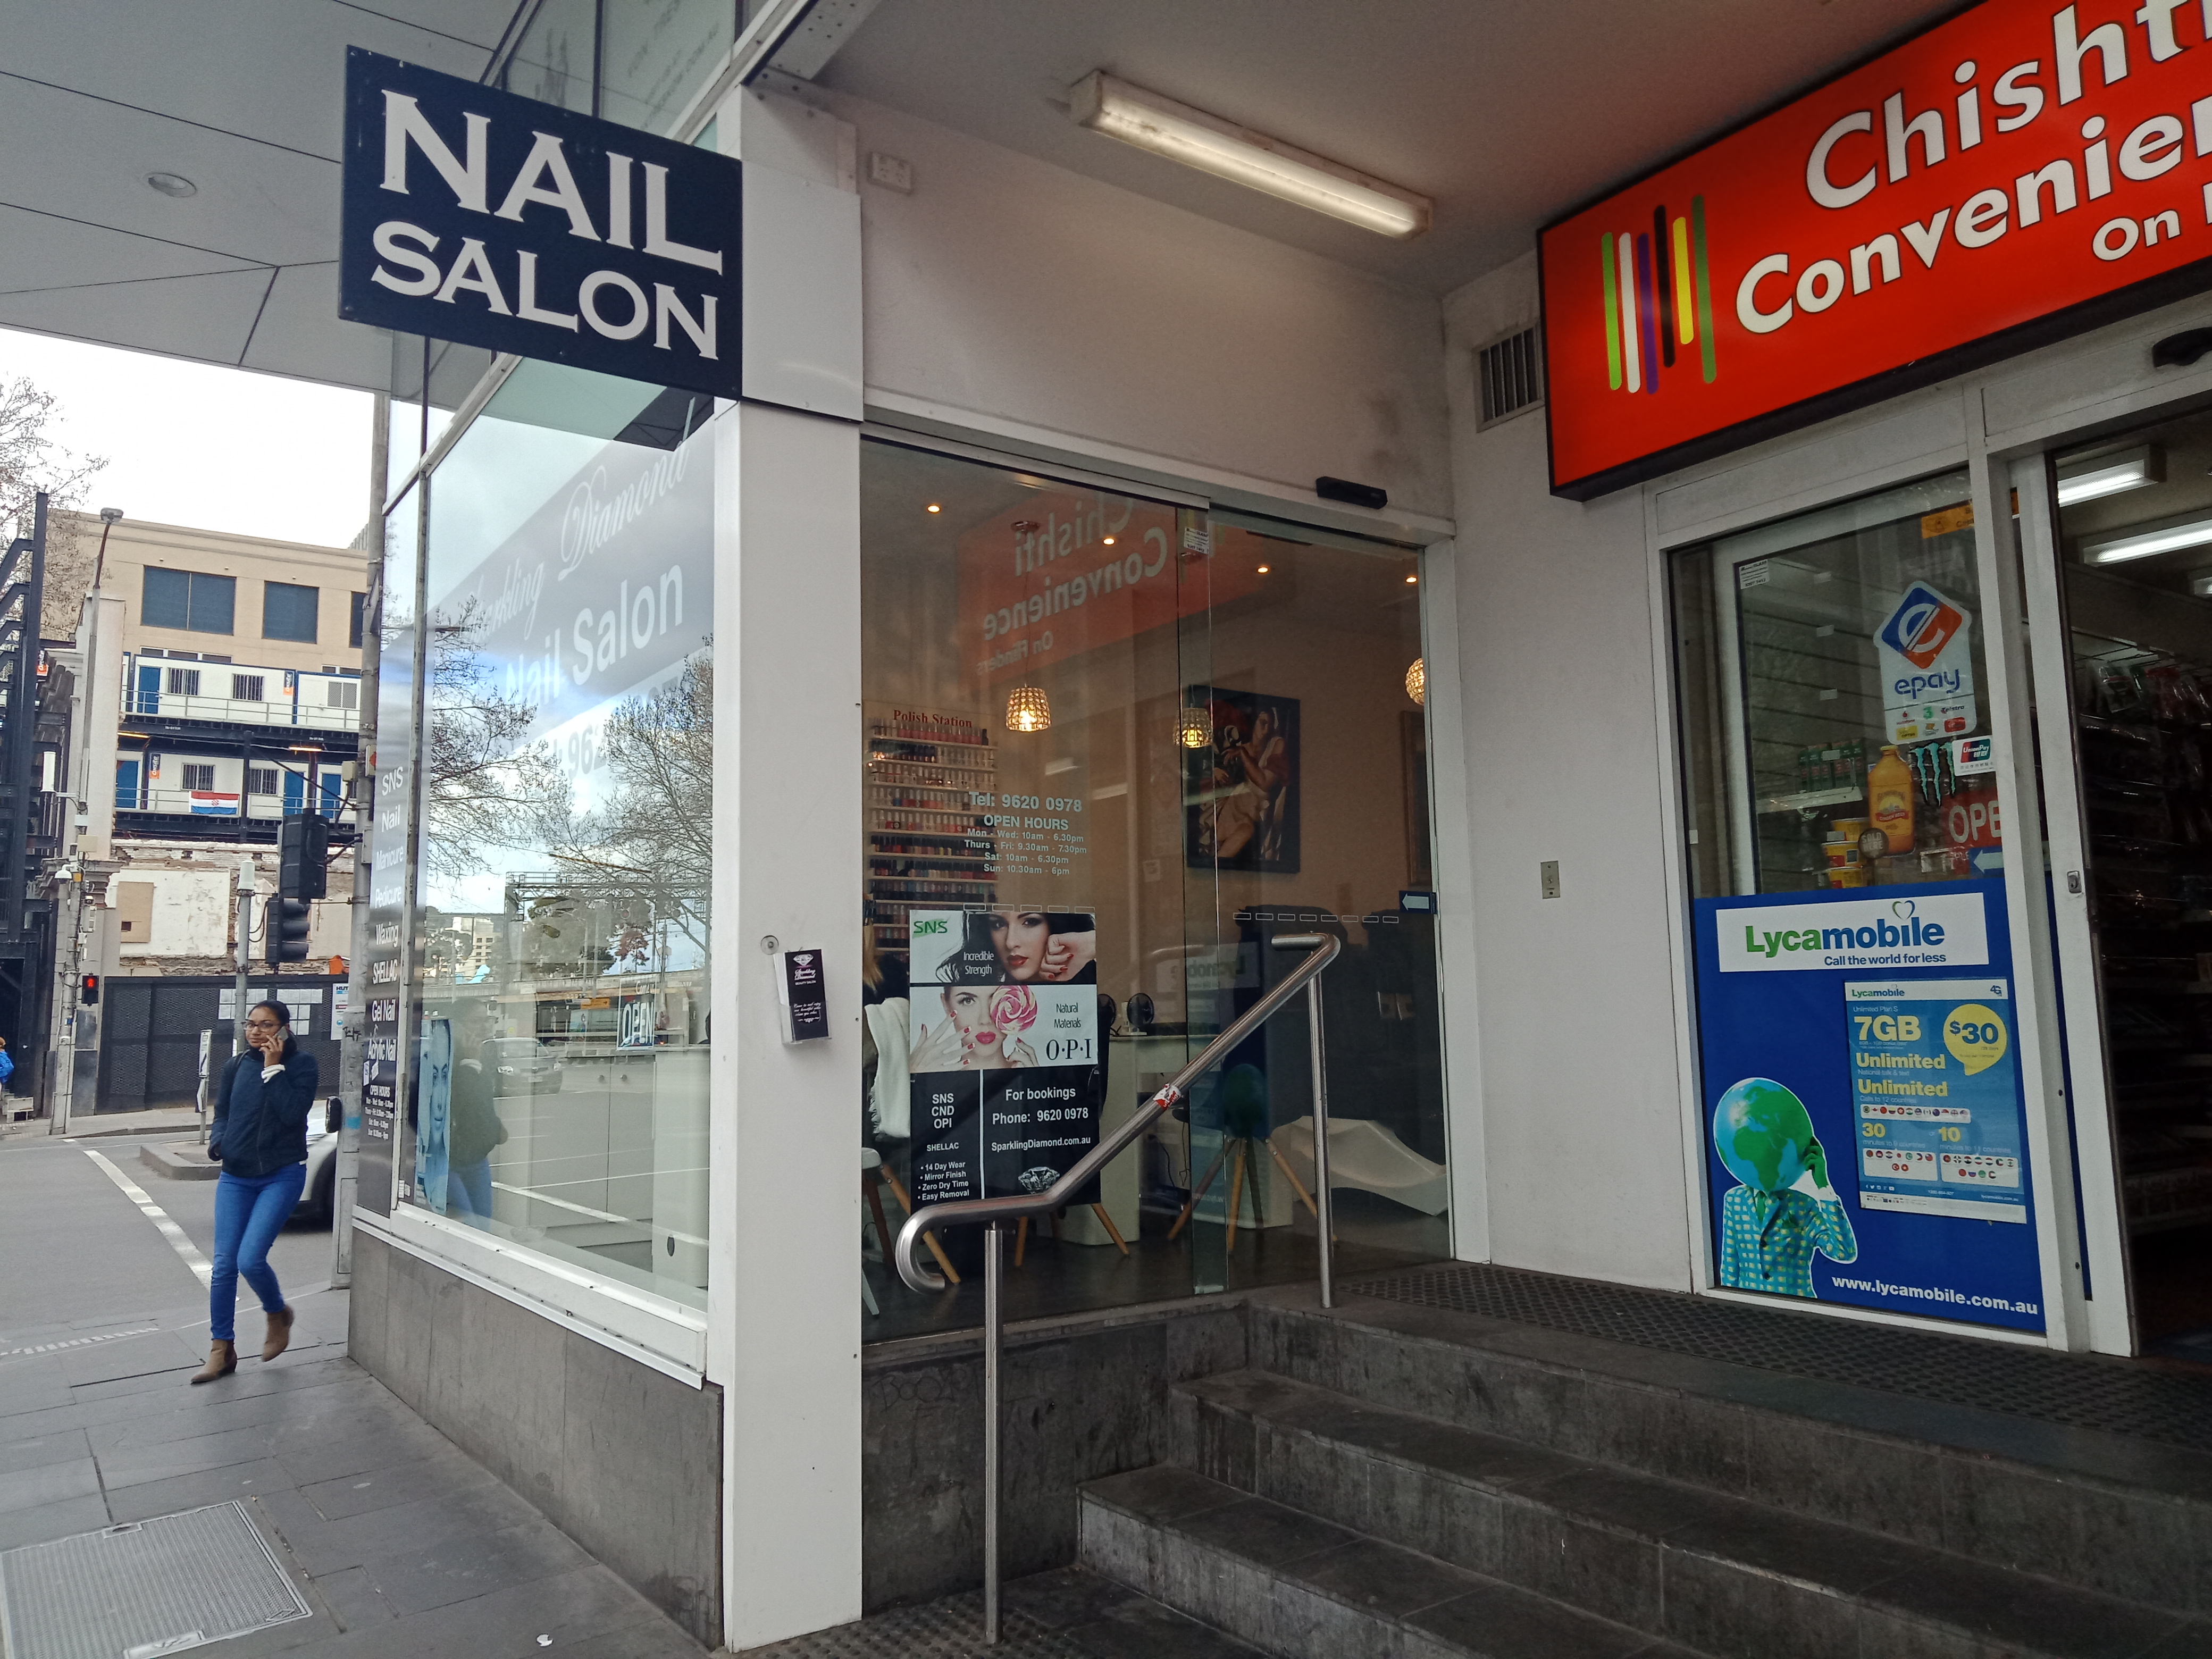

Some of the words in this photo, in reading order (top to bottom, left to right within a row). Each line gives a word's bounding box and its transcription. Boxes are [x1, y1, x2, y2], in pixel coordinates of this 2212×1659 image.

[1807, 0, 2212, 208] Chisht
[380, 89, 722, 275] NAIL
[2093, 210, 2180, 261] On
[371, 221, 718, 360] SALON
[558, 441, 690, 581] Diamond
[506, 627, 560, 705] Nail
[572, 565, 682, 685] Salon
[1895, 669, 1960, 699] epay
[893, 709, 928, 723] Polish
[932, 714, 972, 728] Station
[568, 719, 609, 782] 962
[1963, 744, 1989, 753] UnionPay
[382, 766, 403, 796] SNS
[969, 791, 995, 807] Tel:
[1002, 794, 1040, 809] 9620
[1046, 797, 1082, 812] 0978
[381, 805, 400, 833] Nail
[984, 815, 1020, 827] OPEN
[1025, 817, 1069, 830] HOURS
[1949, 800, 2001, 844] OPE
[967, 828, 987, 836] Mon
[997, 830, 1018, 839] Wed:
[1022, 832, 1044, 840] 10am
[1053, 833, 1084, 843] 6.30pm
[965, 840, 990, 848] Thurs
[1018, 843, 1049, 851] 9.30am
[376, 846, 403, 871] Manicure
[1038, 855, 1069, 865] 6.30pm
[1007, 865, 1042, 874] 10.30am
[1052, 867, 1069, 875] 6pm
[375, 885, 401, 909] Pedicure
[376, 921, 399, 948] Waxing
[914, 921, 948, 934] SNS
[1745, 916, 1945, 958] Lycamobile
[963, 951, 994, 961] Incredible
[1824, 956, 1845, 966] Call
[1848, 956, 1866, 965] the
[1868, 954, 1901, 964] world
[1903, 953, 1920, 963] for
[1922, 953, 1946, 962] less
[373, 959, 398, 984] SHELLAC
[965, 965, 992, 976] Strength
[1852, 988, 1905, 998] Lycamobile
[1990, 985, 2002, 995] 4G
[372, 1000, 382, 1022] Gel
[383, 999, 396, 1021] Nail
[1056, 1003, 1078, 1013] Natural
[622, 1002, 653, 1045] OPEN
[1054, 1018, 1081, 1028] Materials
[1854, 1015, 1922, 1041] 7GB
[1950, 1020, 1999, 1044] $30
[386, 1039, 397, 1061] Nail
[1856, 1052, 1946, 1069] Unlimited
[1006, 1089, 1023, 1101] For
[1027, 1087, 1076, 1100] bookings
[1858, 1079, 1948, 1096] Unlimited
[932, 1093, 954, 1104] SNS
[931, 1105, 954, 1116] CND
[993, 1112, 1030, 1125] Phone:
[1037, 1109, 1062, 1122] 9620
[1065, 1108, 1088, 1120] 0978
[934, 1118, 952, 1129] OPI
[1862, 1122, 1886, 1138] 30
[1939, 1127, 1960, 1142] 10
[927, 1143, 959, 1152] SHELLAC
[992, 1137, 1091, 1152] SparklingDiamond.com.au
[939, 1182, 951, 1190] Dry
[922, 1192, 939, 1201] Easy
[940, 1189, 969, 1199] Removal
[1832, 1277, 2038, 1314] www.lycamobile.com.au
